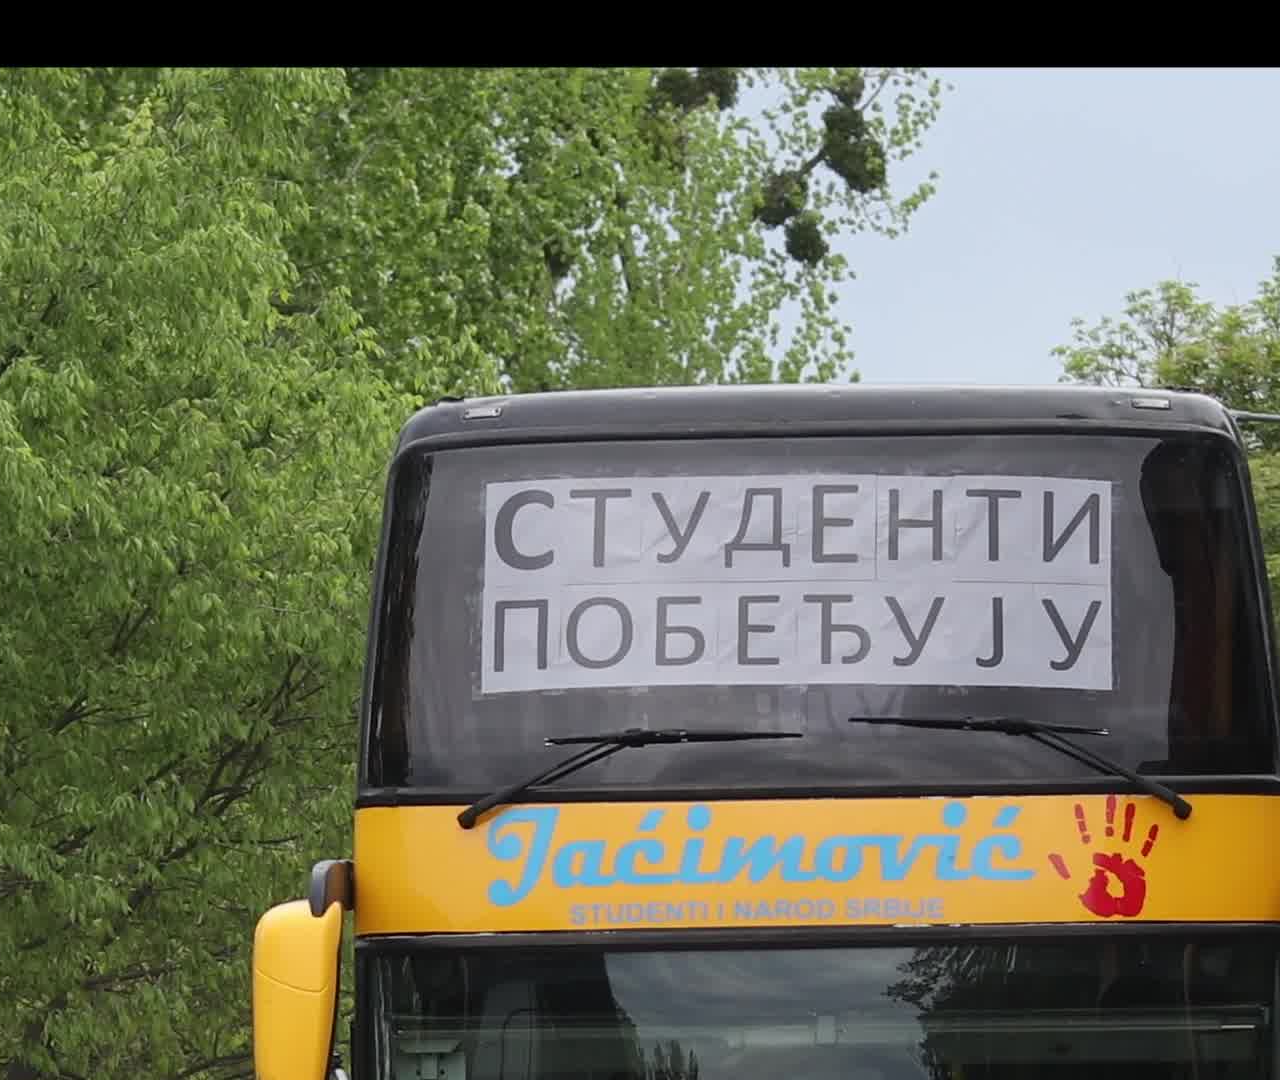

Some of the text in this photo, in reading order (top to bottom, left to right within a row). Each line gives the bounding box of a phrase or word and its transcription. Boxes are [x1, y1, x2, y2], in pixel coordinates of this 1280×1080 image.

[493, 484, 1101, 571] СТУДЕНТИ
[493, 594, 1102, 673] ПОБЕЂУЈУ
[486, 802, 1037, 907] Jaćimović
[569, 897, 945, 926] STUDENTI I NAROD SRBIJE
